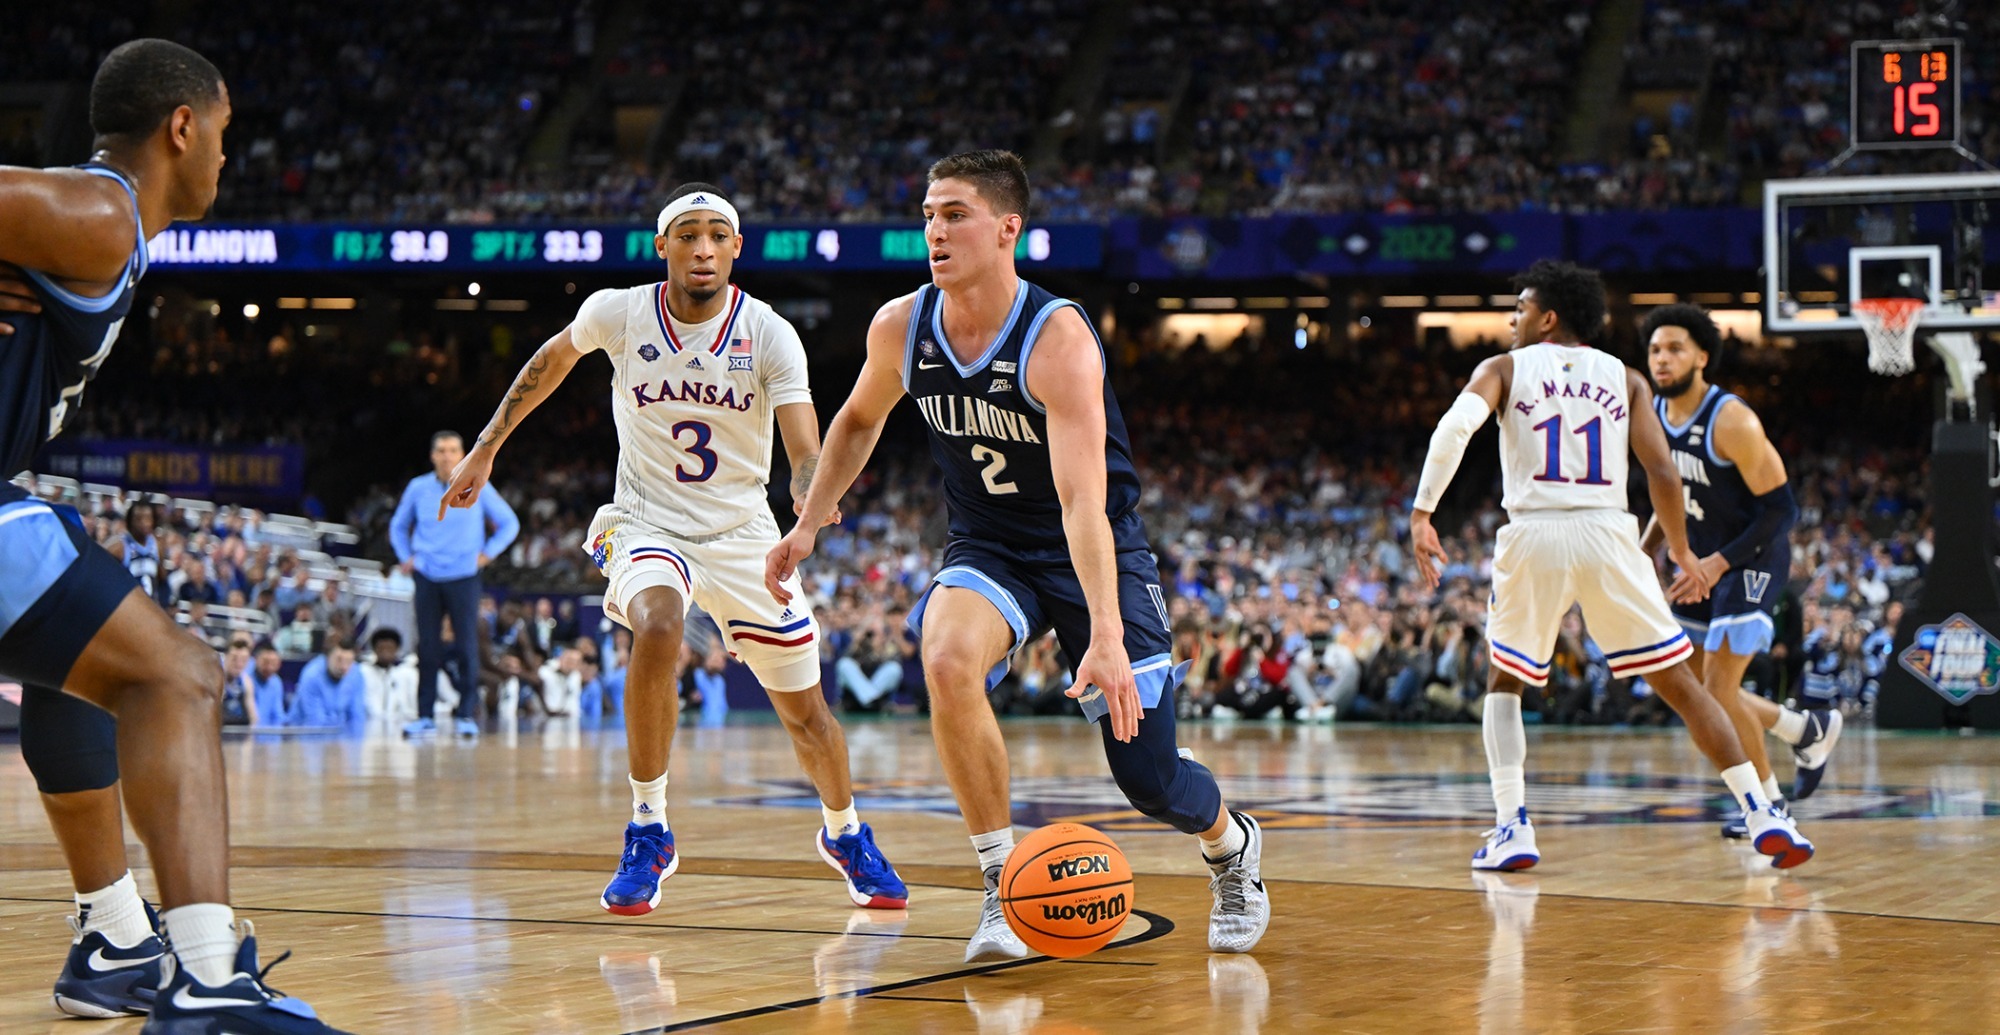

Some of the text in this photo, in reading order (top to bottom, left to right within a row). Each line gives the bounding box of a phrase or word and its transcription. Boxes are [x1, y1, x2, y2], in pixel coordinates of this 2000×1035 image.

[1883, 51, 1947, 83] 6 13
[1893, 82, 1940, 136] 15
[543, 230, 603, 262] 33.3
[762, 229, 840, 262] AST 4
[1379, 225, 1455, 260] 2022
[632, 379, 755, 412] KANSAS
[1515, 380, 1626, 422] R. MARTIN
[916, 394, 1042, 444] VILLANOVA
[671, 420, 719, 483] 3
[1533, 414, 1612, 485] 11
[128, 452, 201, 484] ENDS
[209, 453, 284, 486] HERE
[971, 443, 1020, 495] 2
[1743, 569, 1771, 604] V
[1933, 631, 1986, 655] FINAL
[1929, 654, 1986, 679] FOUR
[1047, 854, 1110, 881] NCAA
[1043, 893, 1126, 925] Wilson
